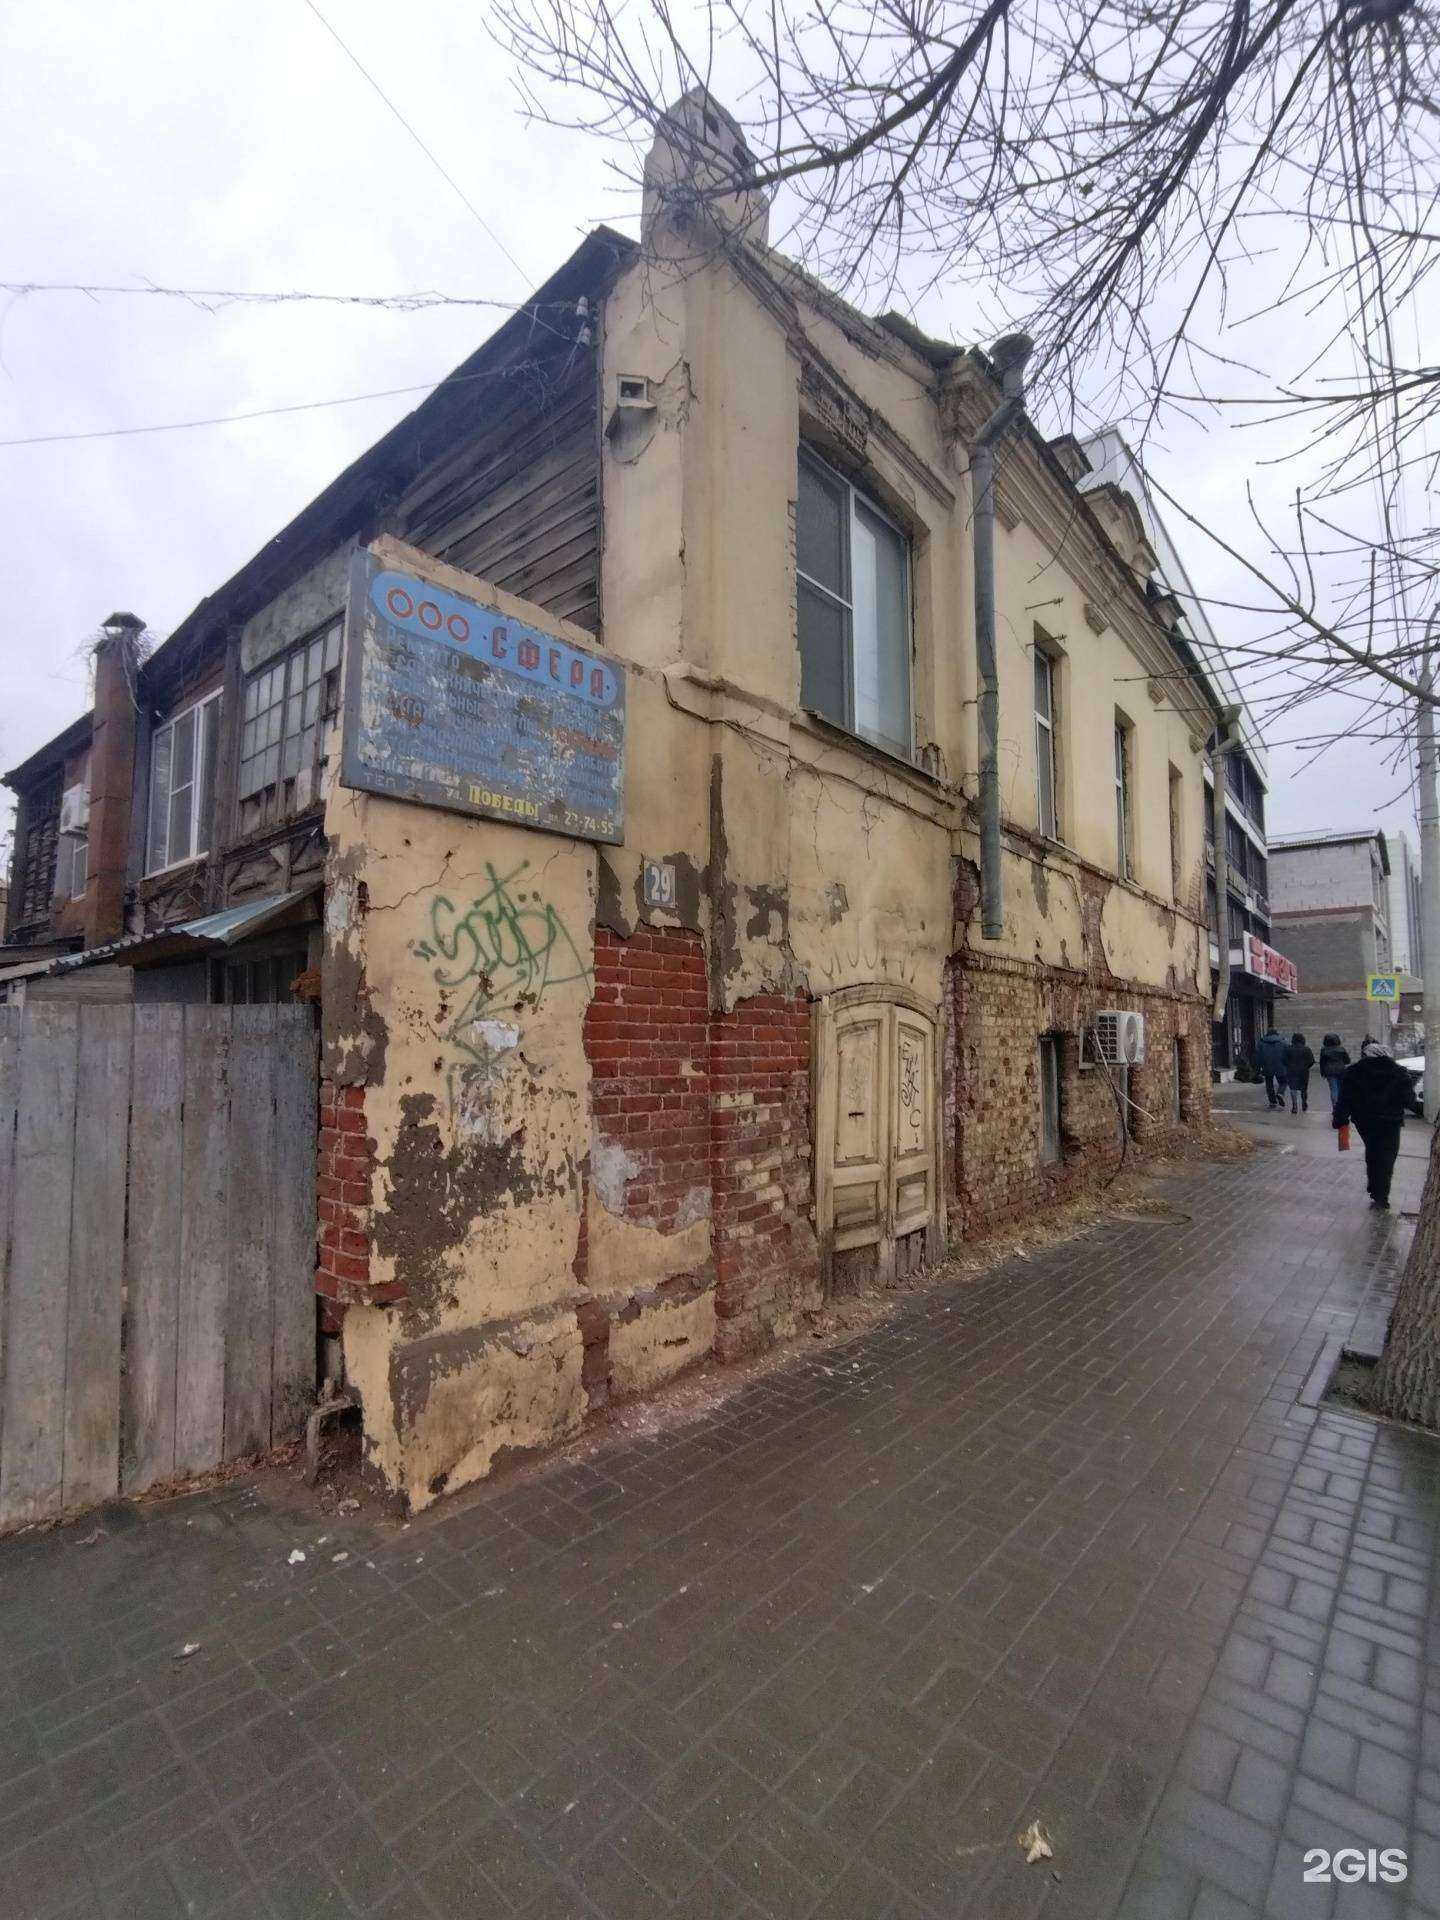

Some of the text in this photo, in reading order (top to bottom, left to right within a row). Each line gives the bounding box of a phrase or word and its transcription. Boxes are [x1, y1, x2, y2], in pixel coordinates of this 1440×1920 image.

[386, 587, 604, 699] ООО СФЕРА
[650, 866, 671, 902] 29
